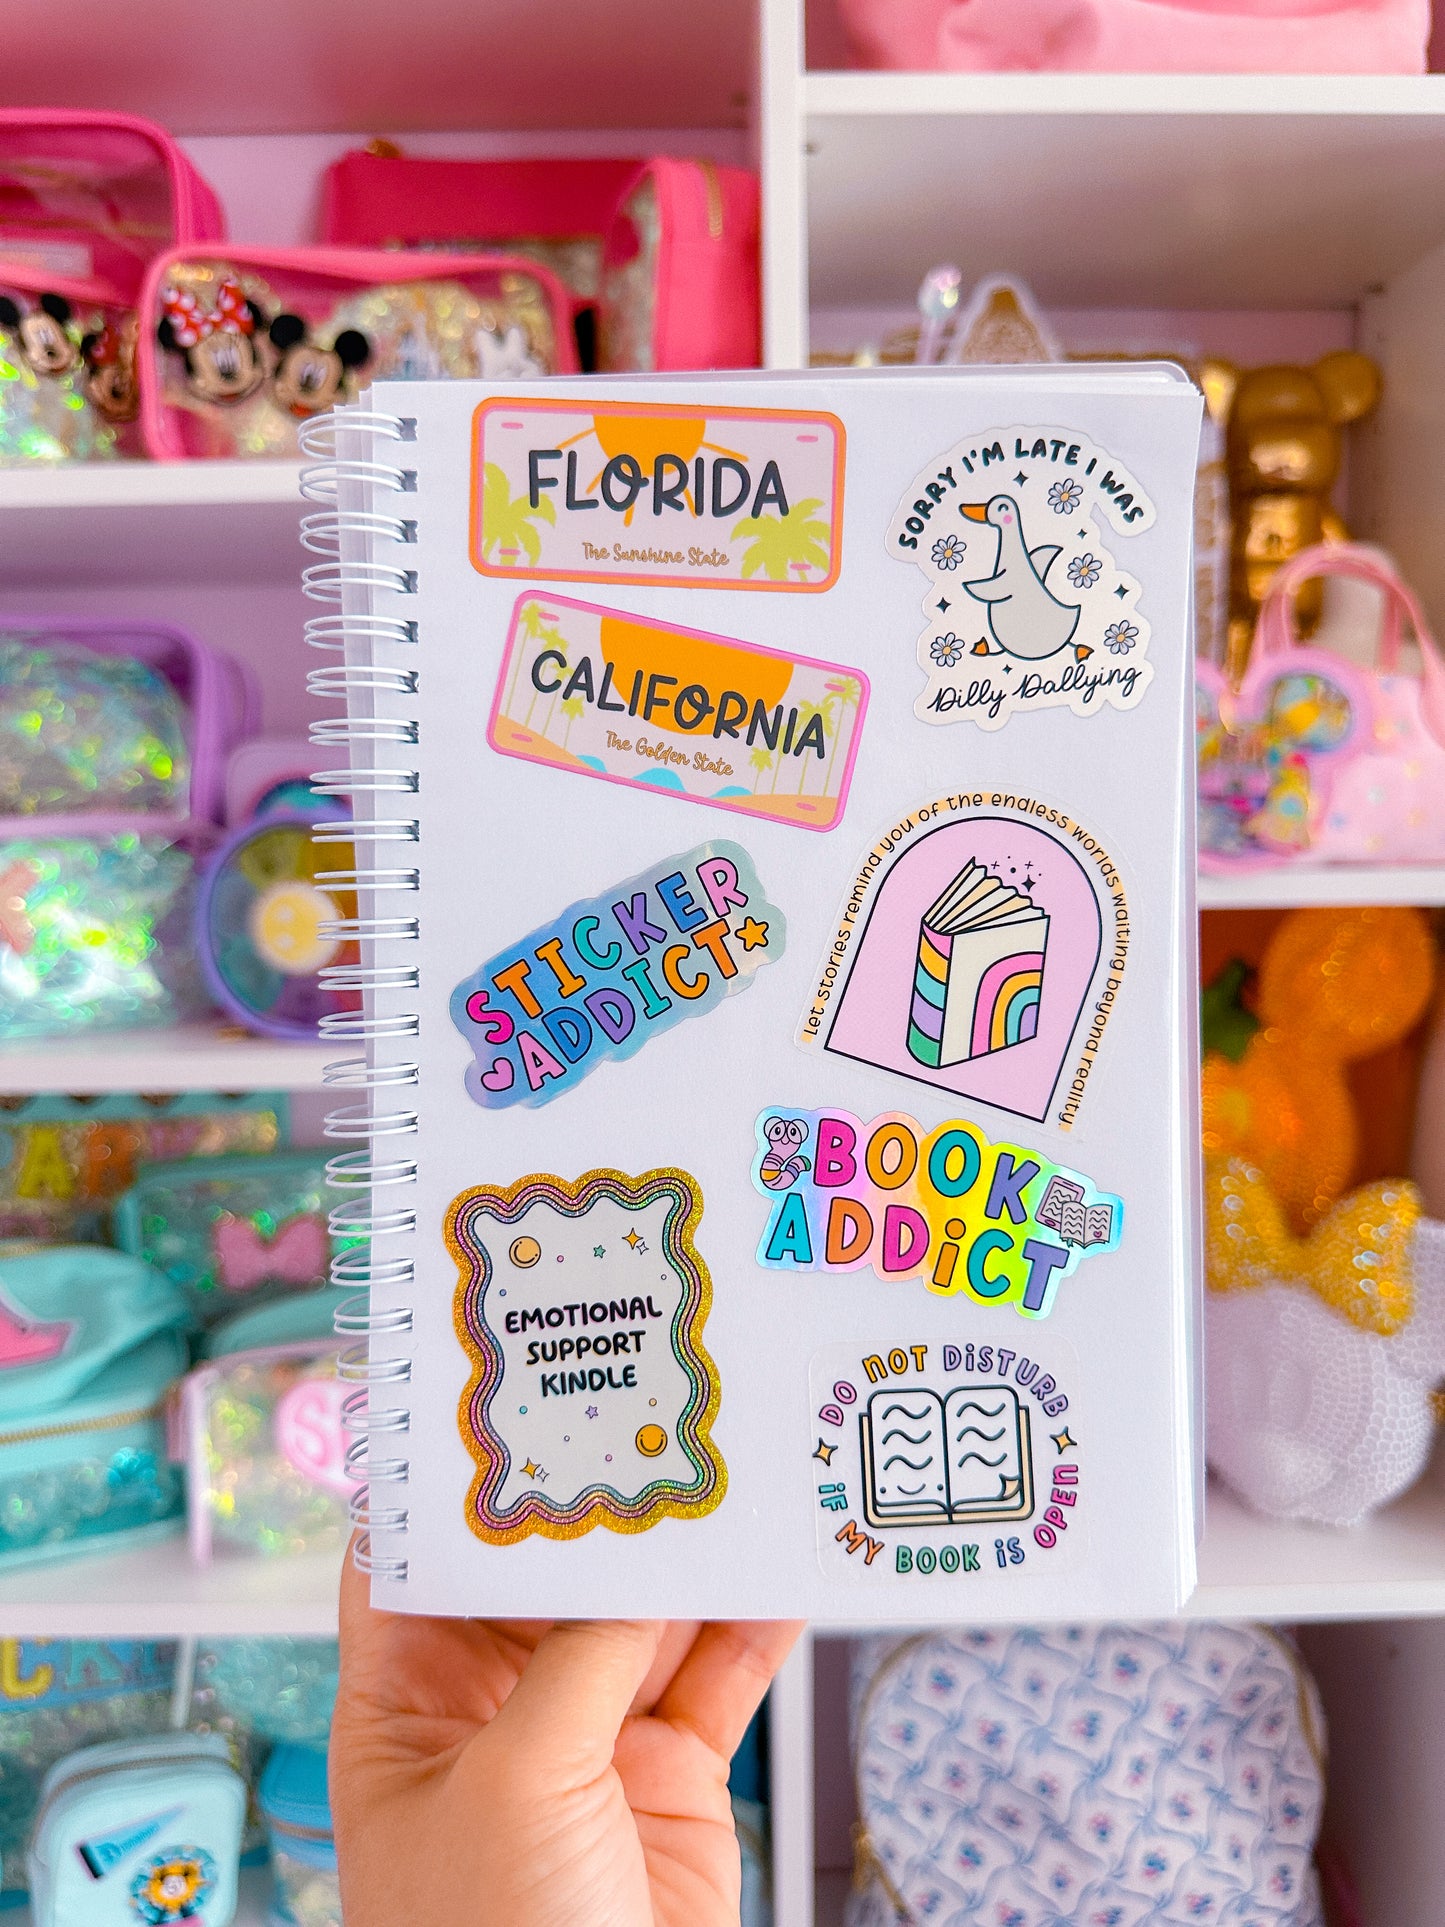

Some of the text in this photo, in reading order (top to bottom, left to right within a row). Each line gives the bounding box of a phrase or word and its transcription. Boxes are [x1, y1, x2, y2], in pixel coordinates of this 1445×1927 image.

[528, 449, 789, 518] FLORIDA
[899, 438, 1144, 550] SORRY I'M LATE I WAS
[582, 542, 730, 567] The Sunshine State
[531, 650, 826, 760] CALIFORNIA
[927, 664, 1142, 718] Dilly Dallying
[606, 730, 734, 776] The Golden State
[918, 802, 938, 822] of
[946, 794, 983, 810] the
[991, 793, 1070, 829] endless
[880, 819, 914, 853] you
[1072, 826, 1120, 888] worlds
[843, 852, 882, 924] remind
[466, 856, 749, 1044] STICKER
[1109, 893, 1130, 971] waiting
[818, 930, 851, 1001] stories
[516, 918, 738, 1091] ADDICT
[804, 1006, 825, 1036] Let
[1084, 978, 1122, 1052] beyond
[813, 1118, 1040, 1225] BOOK
[504, 1296, 663, 1334] EMOTIONAL
[526, 1329, 646, 1366] SUPPORT
[540, 1364, 638, 1398] KINDLE
[818, 1380, 858, 1426] DO
[835, 1519, 884, 1565] MY
[896, 1544, 980, 1574] BOOK
